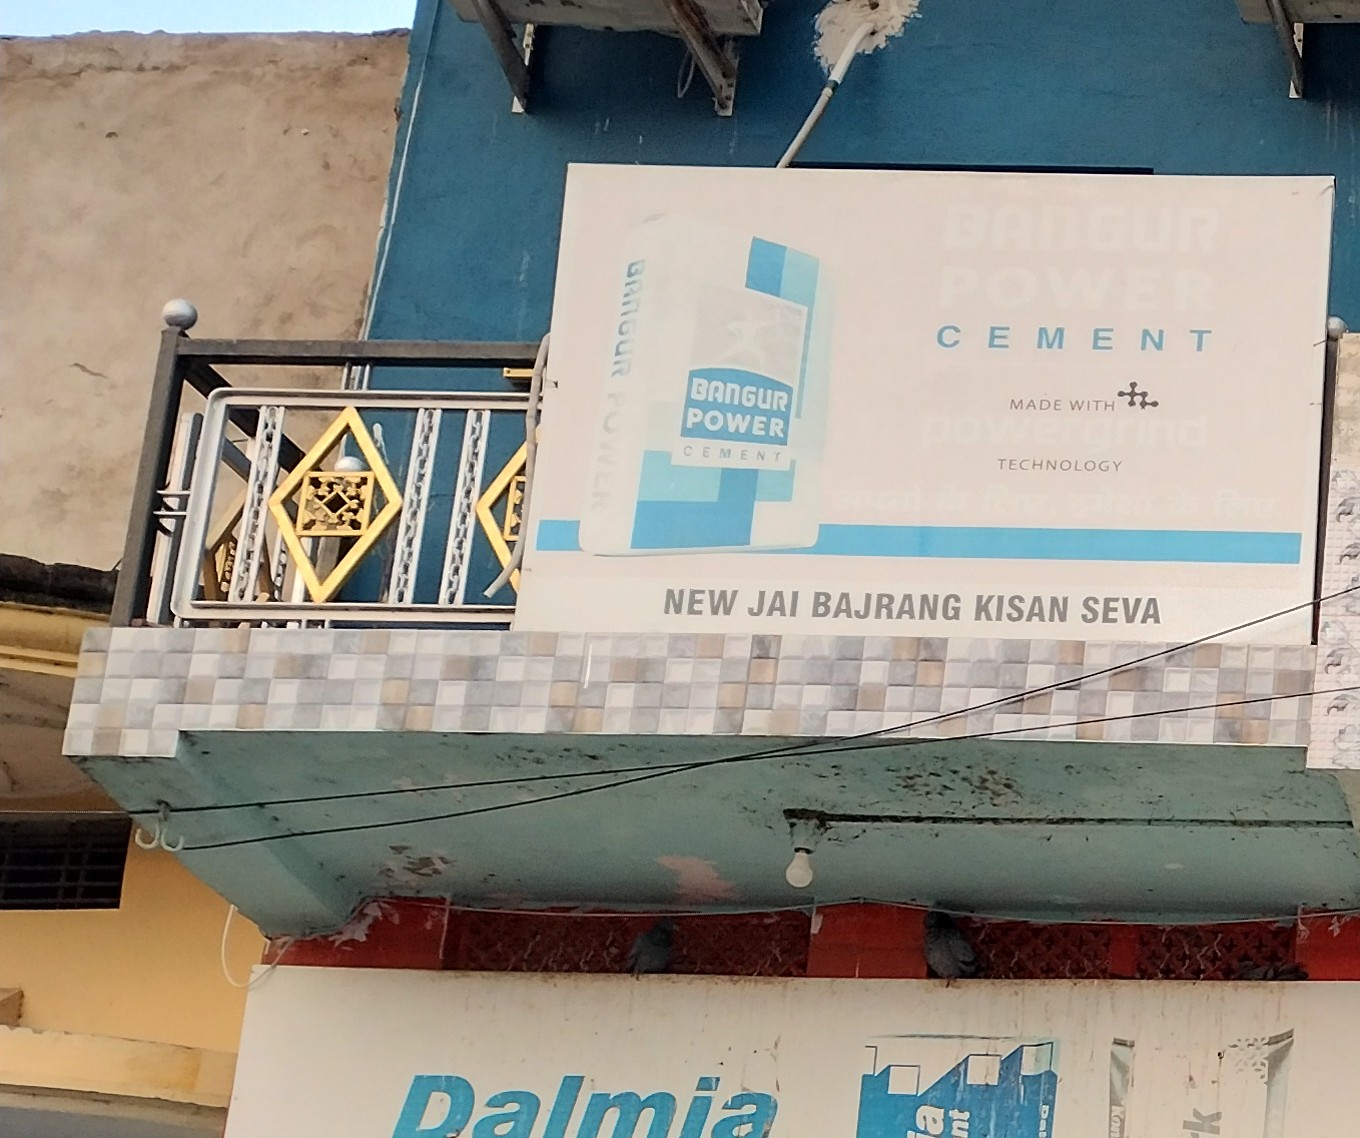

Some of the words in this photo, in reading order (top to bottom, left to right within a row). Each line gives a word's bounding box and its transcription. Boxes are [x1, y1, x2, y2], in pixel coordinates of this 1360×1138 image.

[937, 265, 1216, 313] POWER
[935, 324, 1215, 354] CEMENT
[1008, 397, 1063, 412] MADE
[1067, 398, 1117, 413] WITH
[686, 407, 785, 438] POWER
[682, 444, 784, 462] CEMENT
[998, 457, 1125, 474] TECHNOLOGY
[663, 588, 737, 617] NEW
[746, 590, 799, 619] JAI
[811, 591, 962, 624] BAJRANG
[974, 593, 1076, 625] KISAN
[1080, 595, 1162, 627] SEVA
